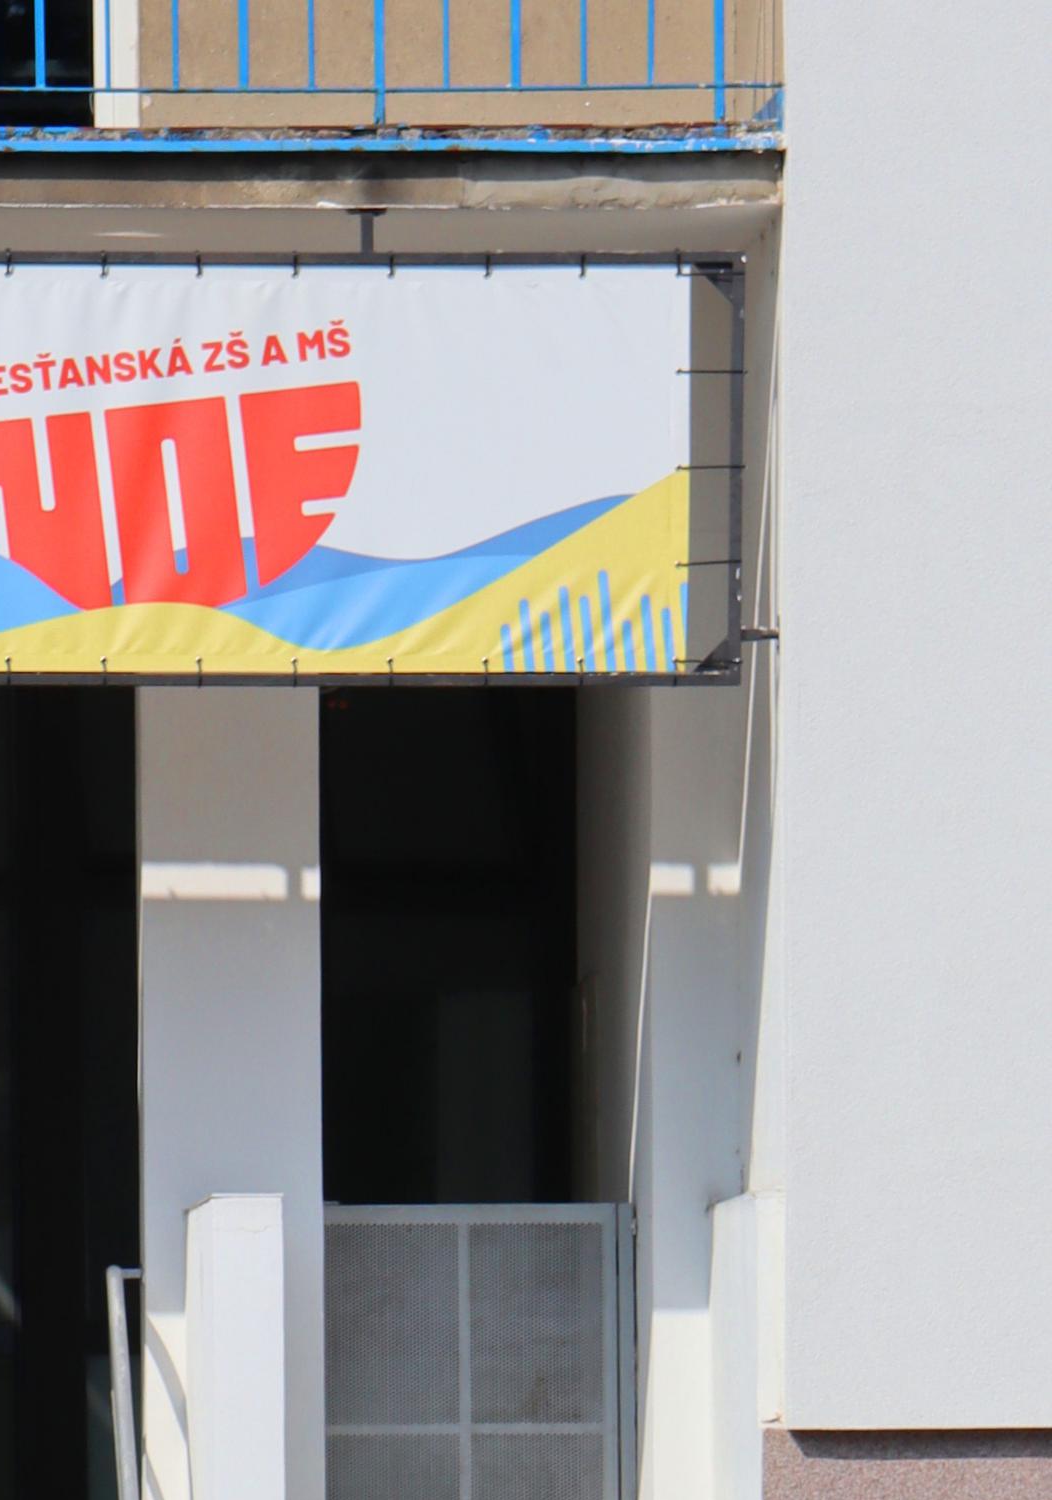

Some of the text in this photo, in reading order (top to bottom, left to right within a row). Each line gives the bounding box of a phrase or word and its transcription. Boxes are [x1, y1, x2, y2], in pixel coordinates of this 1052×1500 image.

[201, 331, 251, 374] ZŠ
[260, 334, 288, 367] A
[296, 319, 351, 363] MŠ
